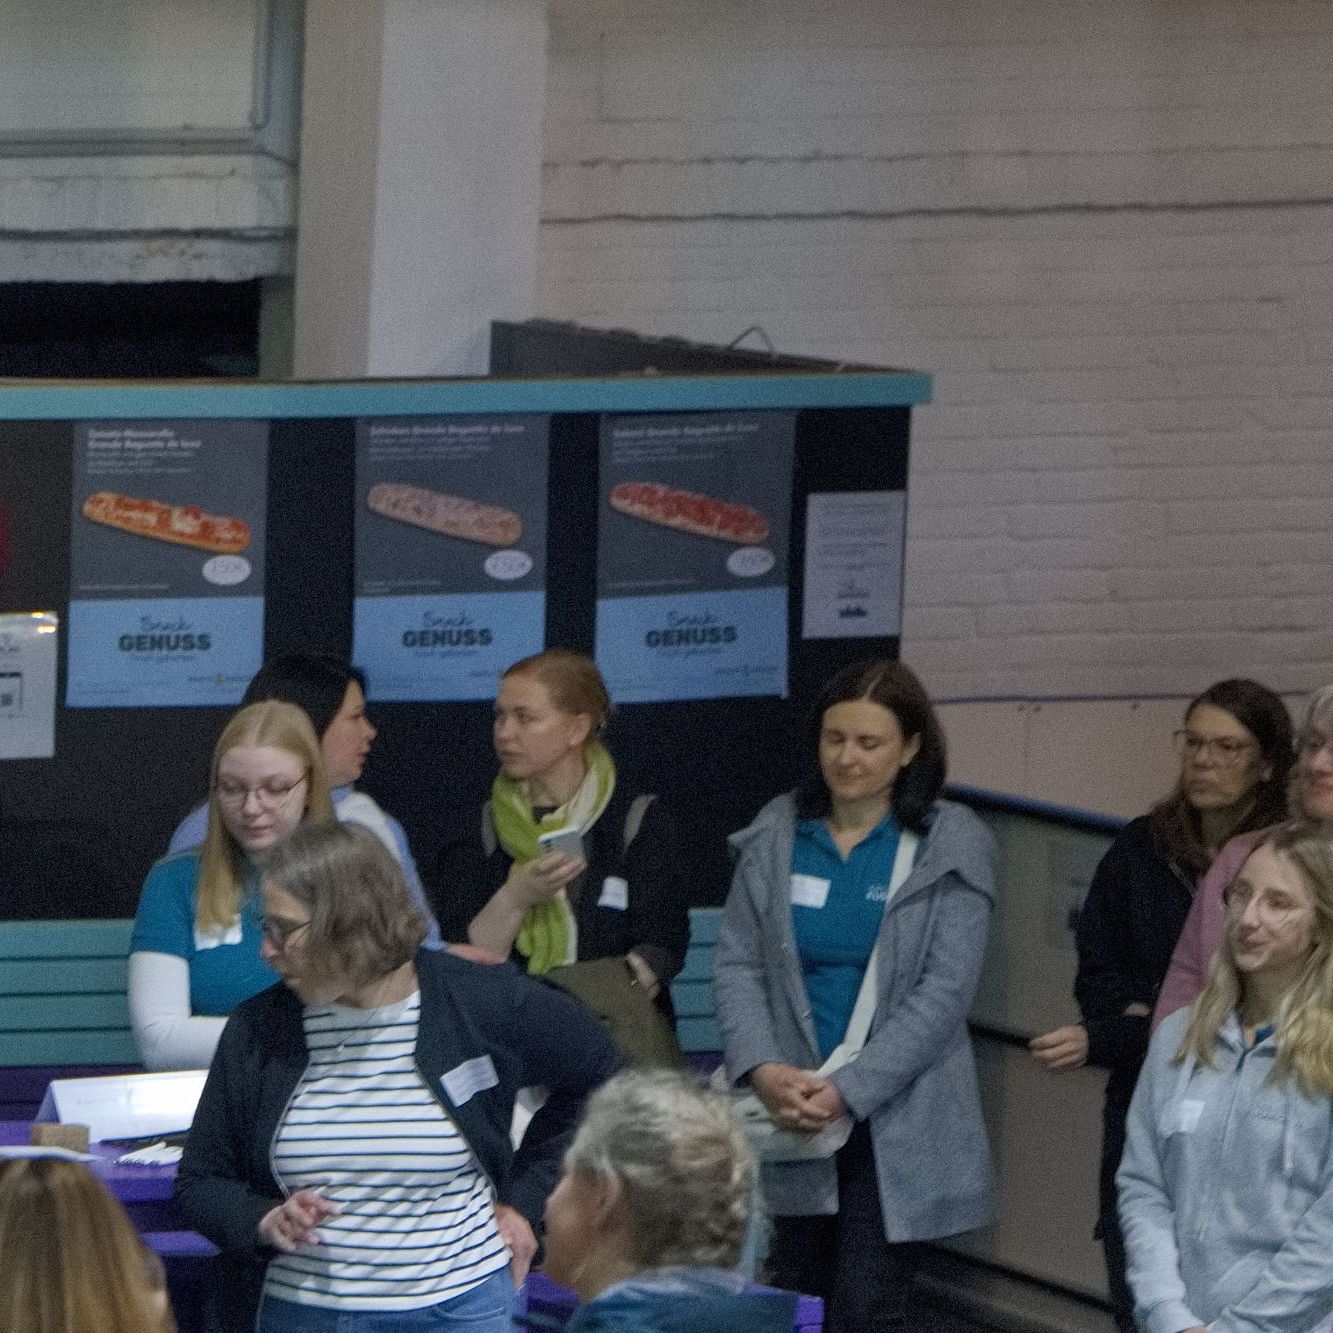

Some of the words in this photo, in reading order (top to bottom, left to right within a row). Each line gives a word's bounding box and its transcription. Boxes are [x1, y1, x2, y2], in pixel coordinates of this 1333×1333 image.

[118, 633, 212, 652] GENUSS
[401, 628, 493, 649] GENUSS
[645, 625, 738, 648] GENUSS
